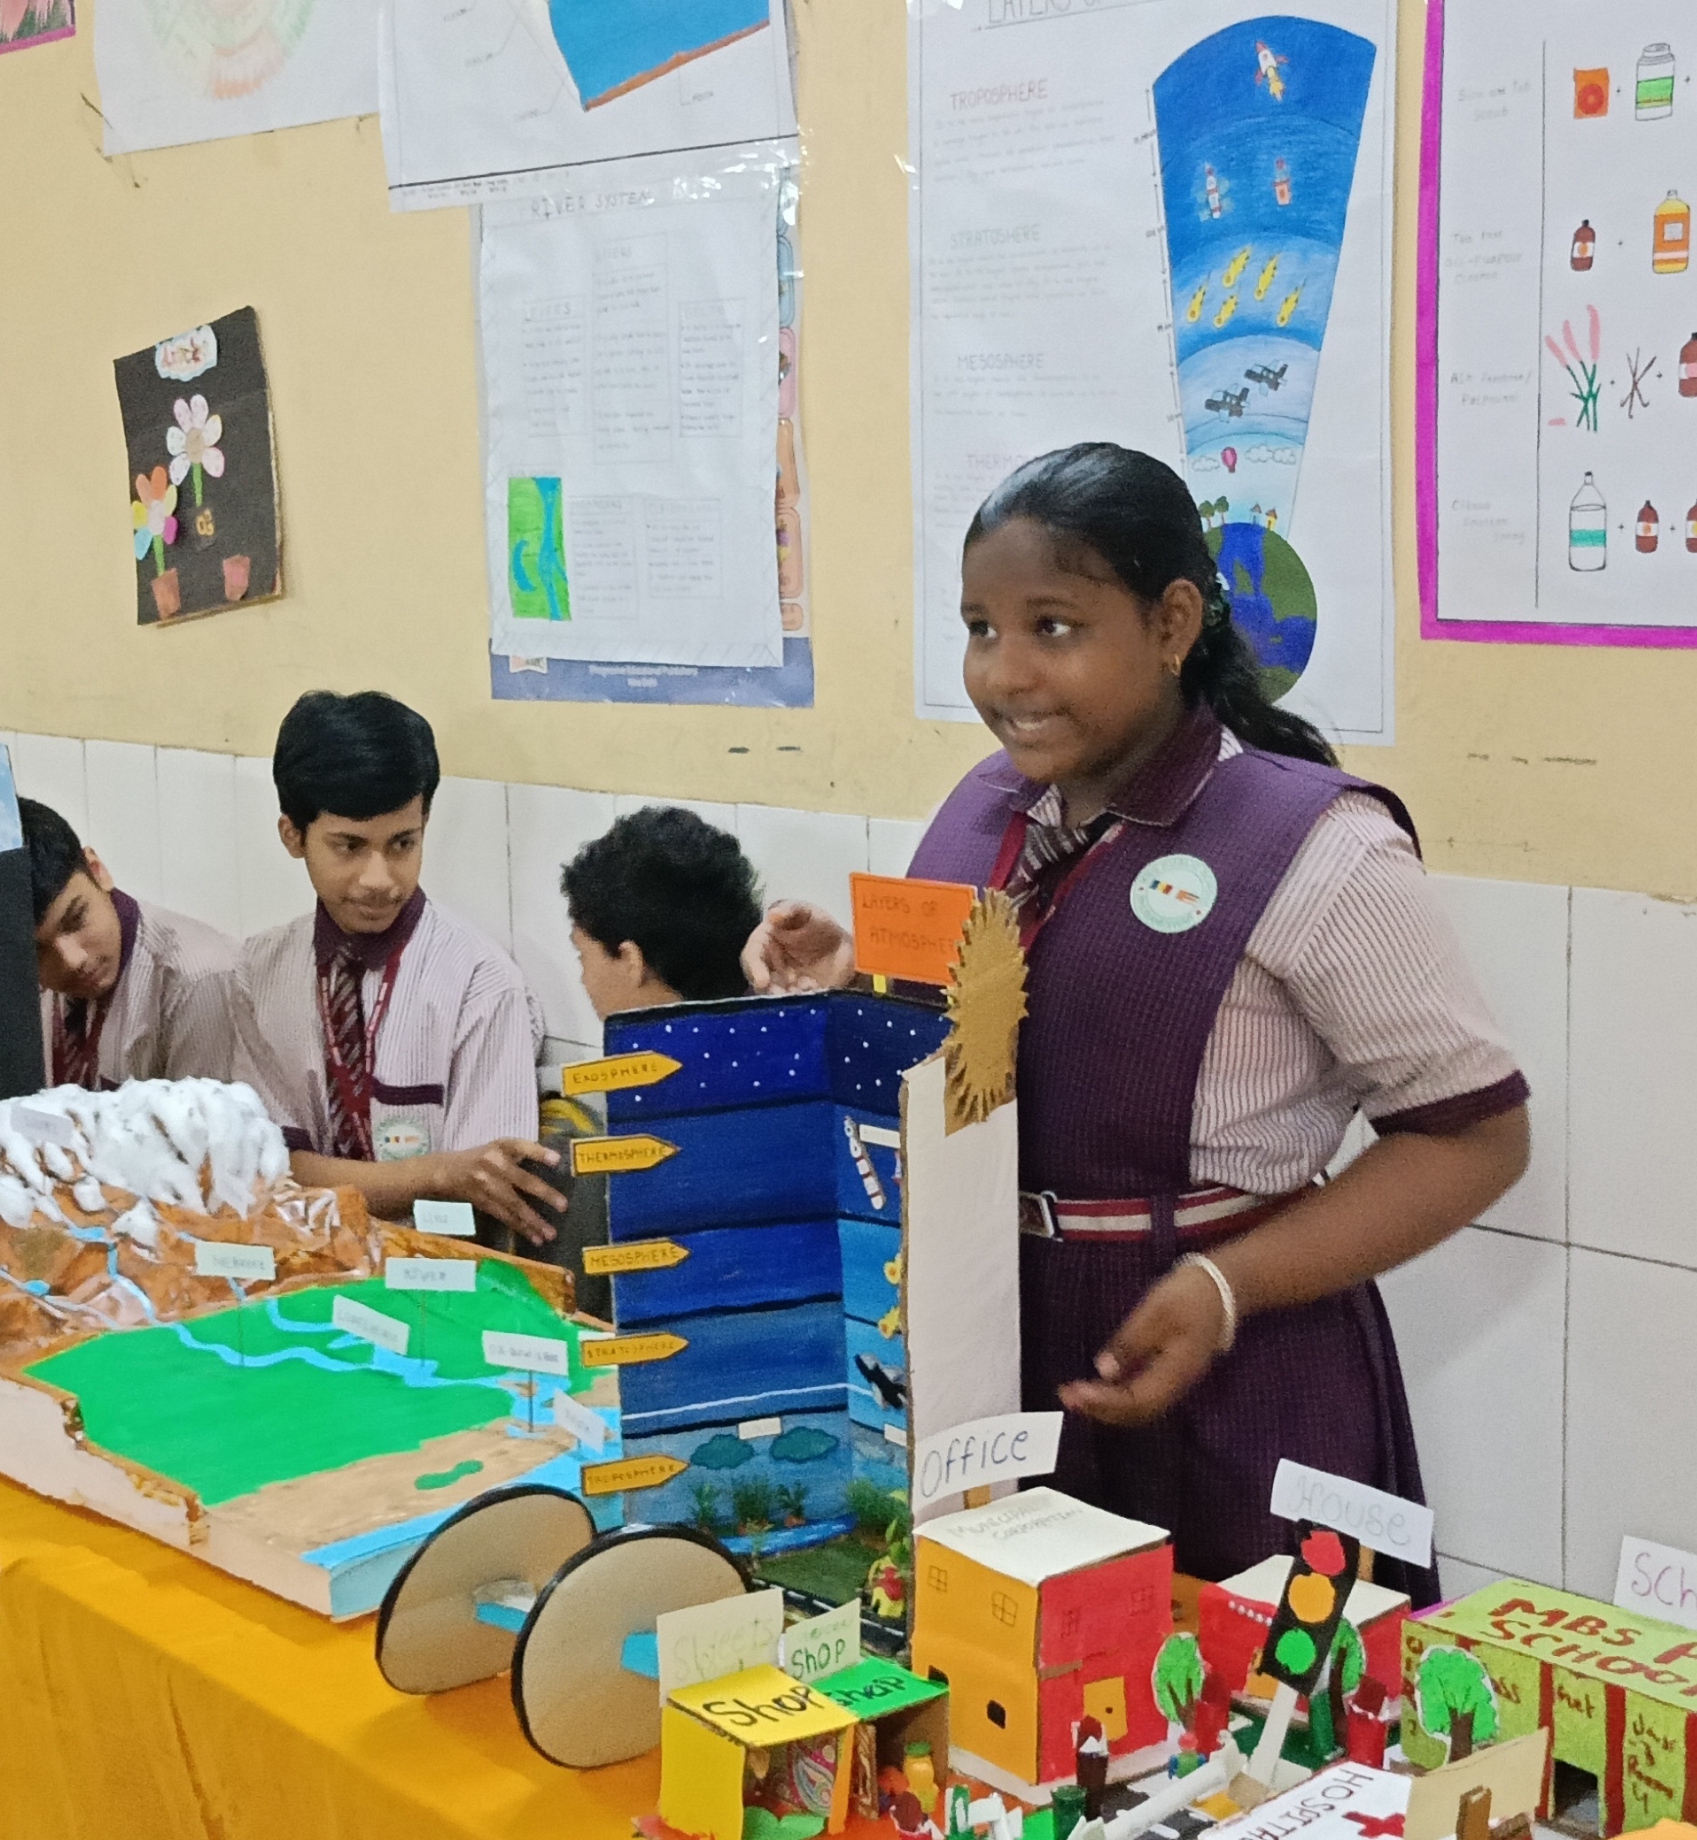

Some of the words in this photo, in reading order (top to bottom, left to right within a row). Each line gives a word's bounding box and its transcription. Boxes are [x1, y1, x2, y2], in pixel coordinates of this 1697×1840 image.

[950, 79, 1048, 111] TROPOSPHERE
[530, 195, 585, 219] RIVER
[572, 1063, 658, 1084] EXOSPHERE
[590, 1245, 680, 1267] MESOSPHERE
[1487, 1597, 1643, 1646] MBS
[1239, 1767, 1375, 1840] HOSPITA
